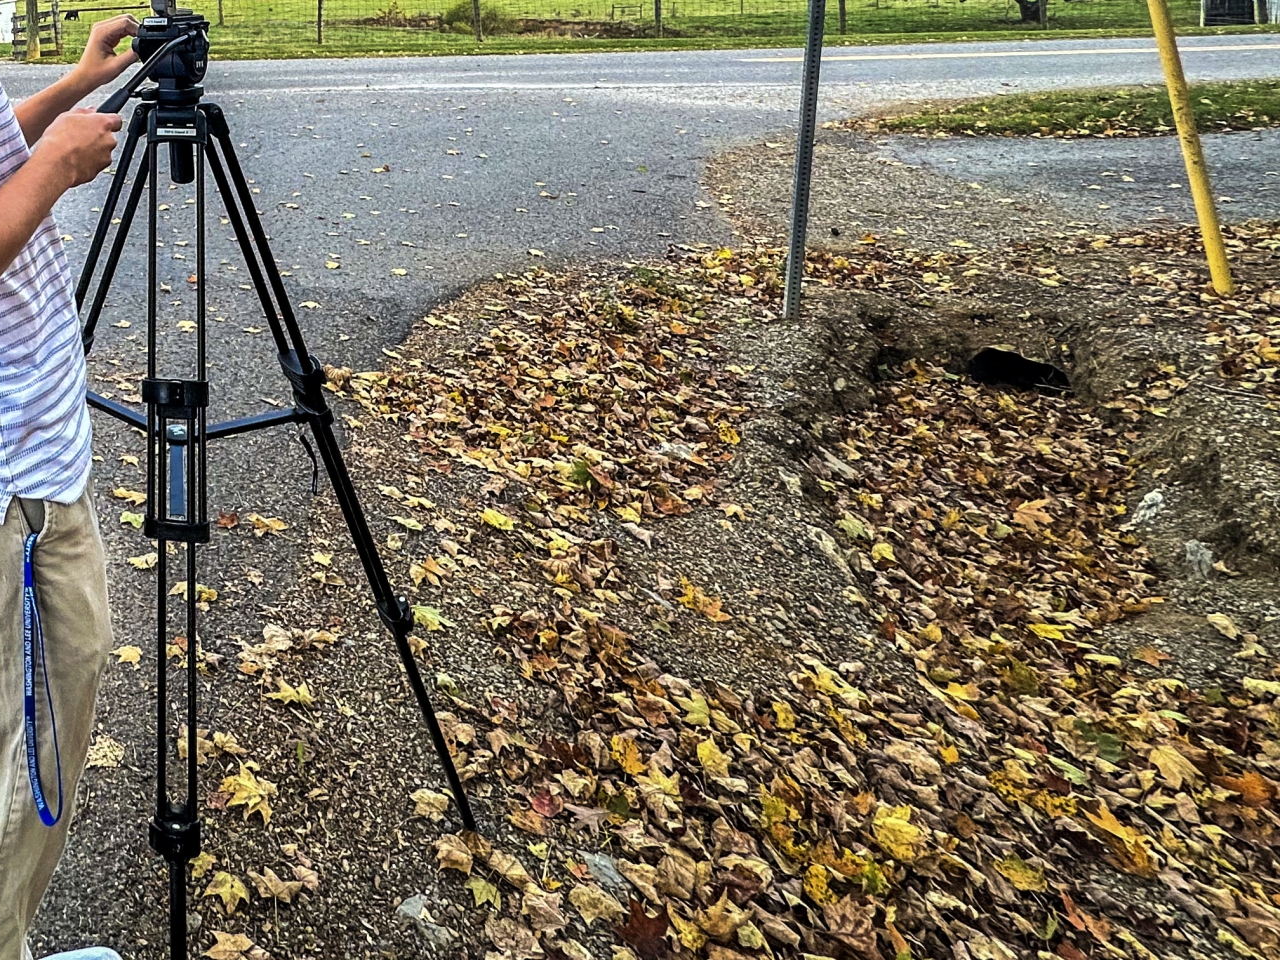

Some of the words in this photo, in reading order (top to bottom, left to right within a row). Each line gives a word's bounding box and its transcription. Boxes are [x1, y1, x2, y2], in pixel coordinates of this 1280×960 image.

[24, 630, 32, 640] LEE
[24, 641, 32, 655] AND
[25, 656, 33, 696] WASHINGTON
[30, 768, 45, 810] WASHINGTON
